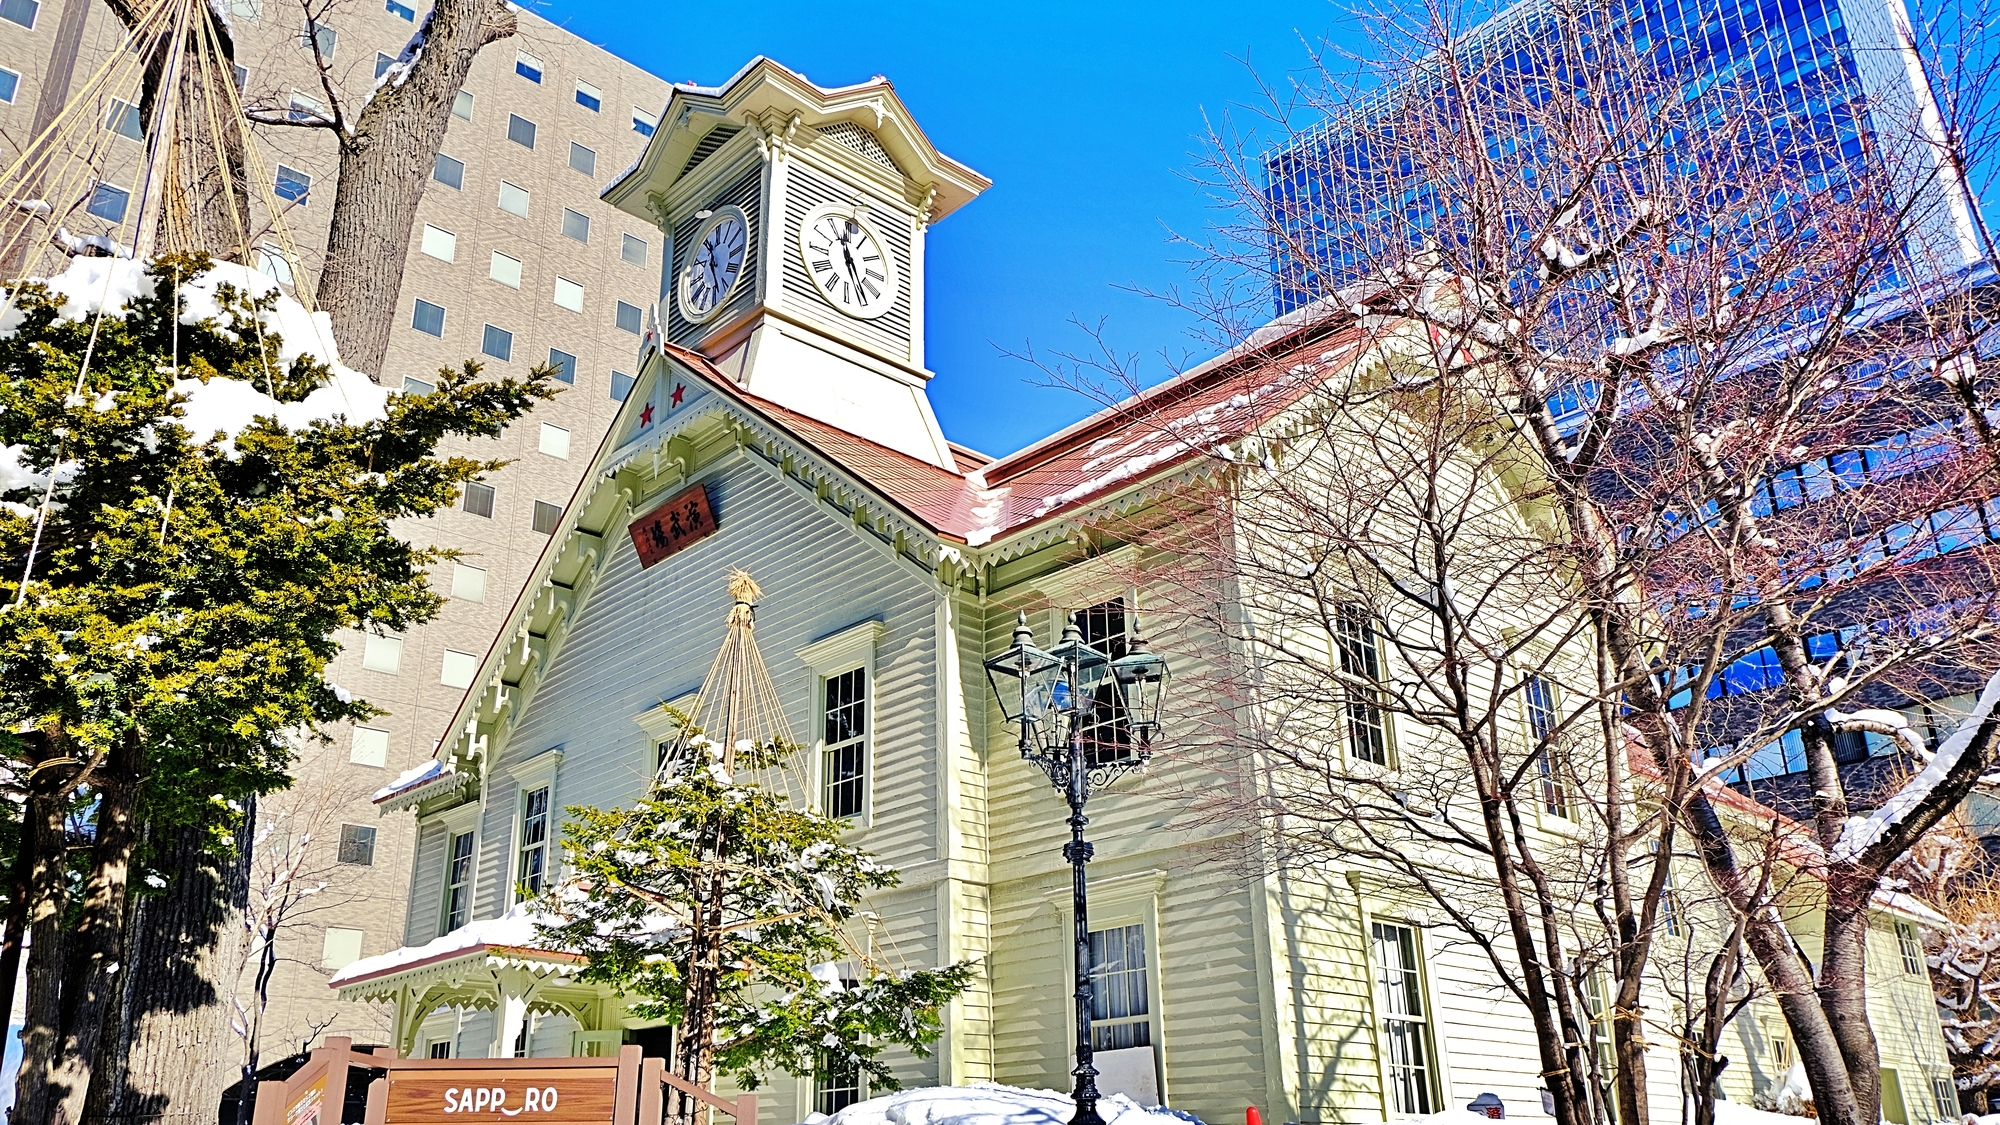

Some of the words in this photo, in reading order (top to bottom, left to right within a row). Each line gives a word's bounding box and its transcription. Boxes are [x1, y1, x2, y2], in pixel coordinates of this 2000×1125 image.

[723, 220, 733, 244] I
[856, 235, 867, 249] I
[721, 277, 729, 292] V
